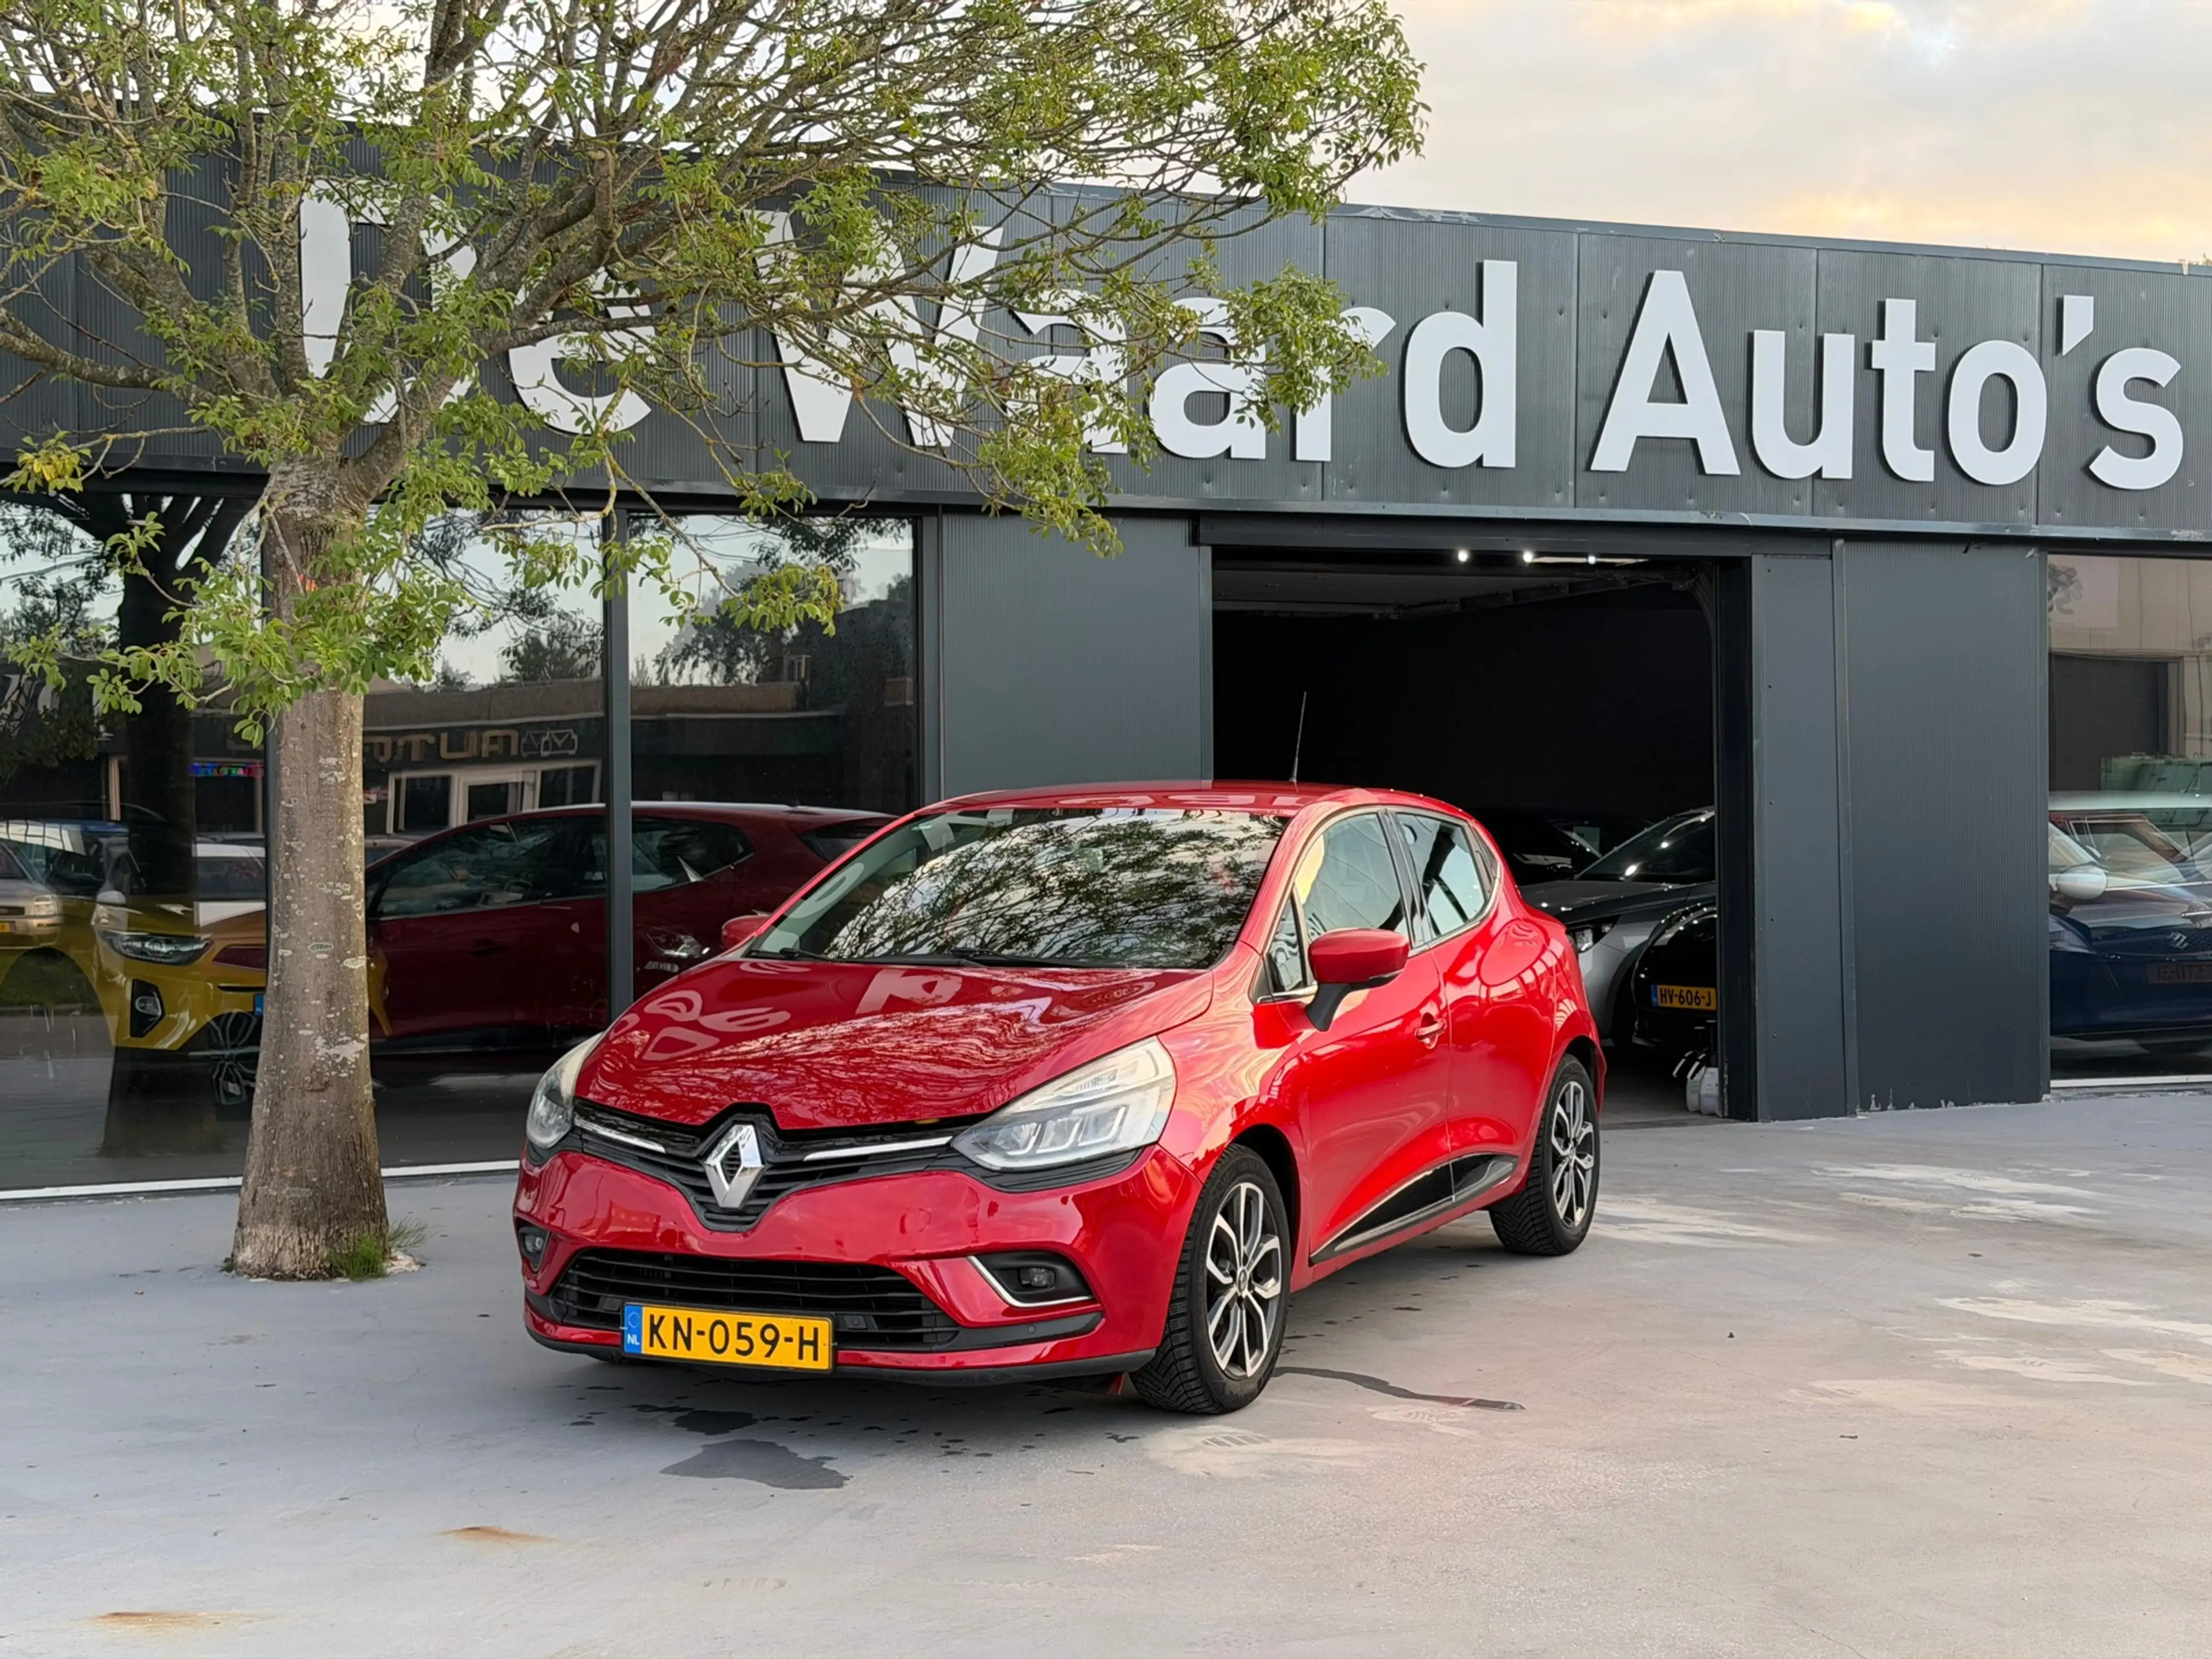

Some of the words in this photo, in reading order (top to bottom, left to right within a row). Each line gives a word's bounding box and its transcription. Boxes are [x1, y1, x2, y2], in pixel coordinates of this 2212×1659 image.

[1590, 270, 2183, 490] Auto's
[1660, 987, 1711, 1007] HV-606-J
[627, 1334, 640, 1346] NL
[649, 1314, 819, 1362] KN-059-H
